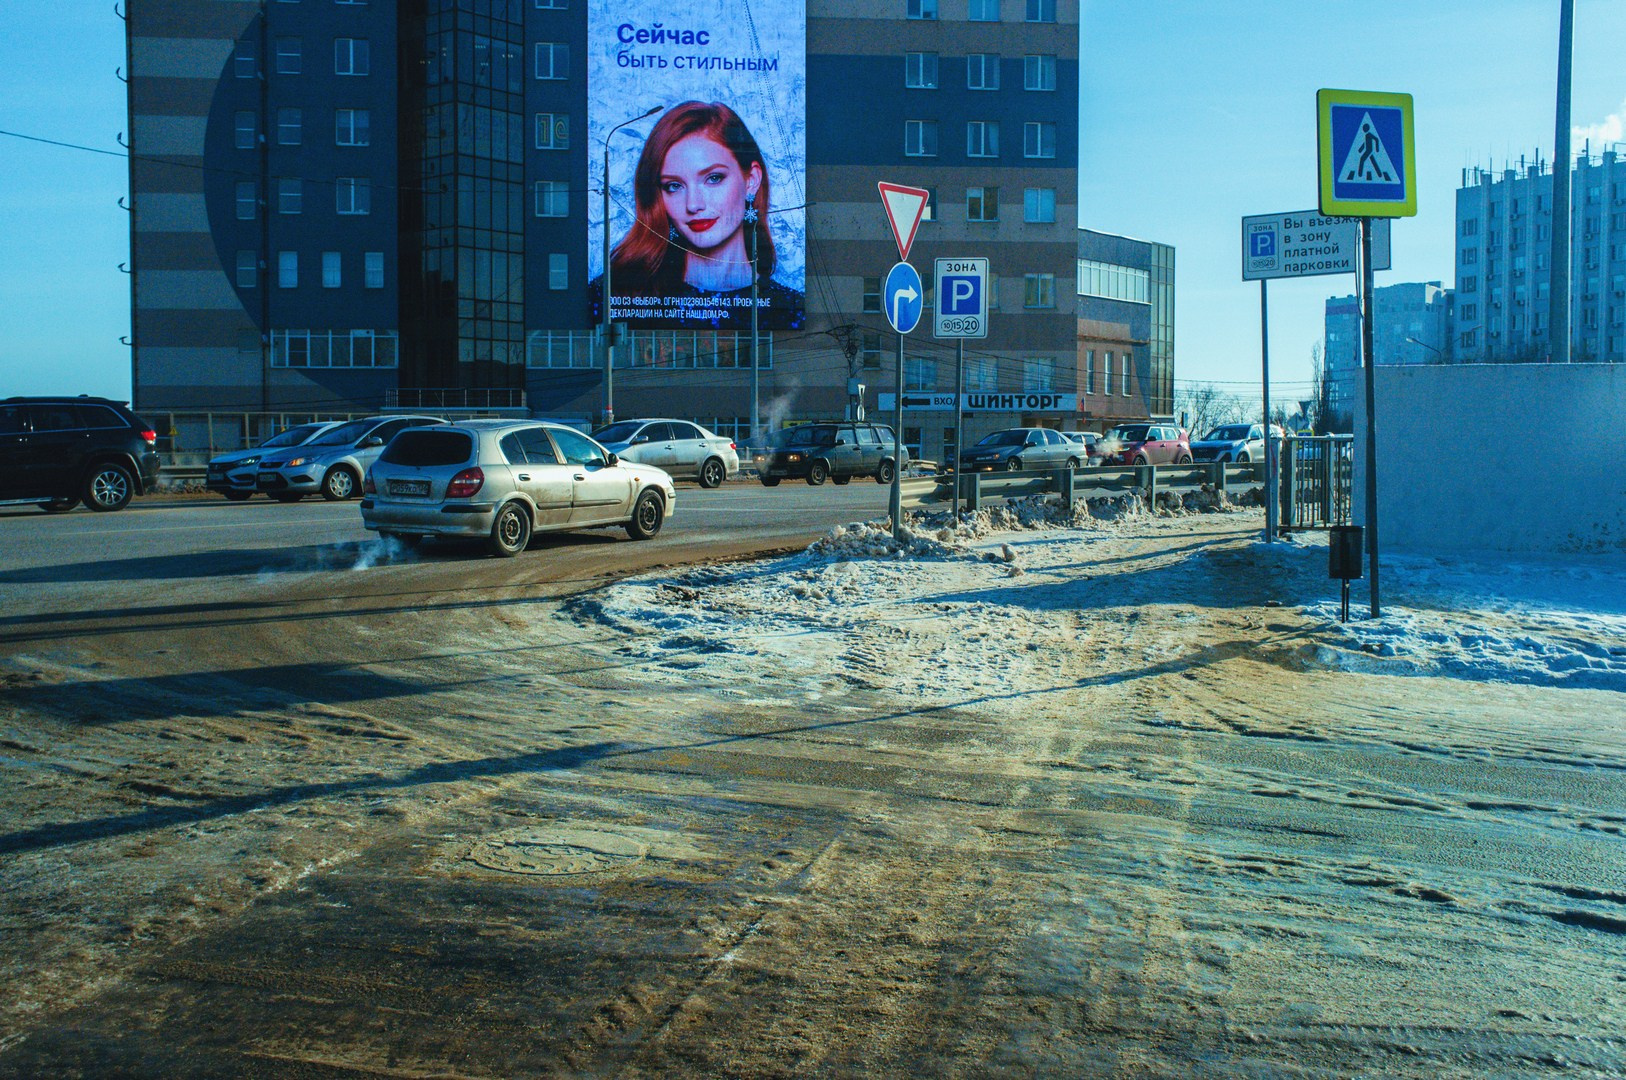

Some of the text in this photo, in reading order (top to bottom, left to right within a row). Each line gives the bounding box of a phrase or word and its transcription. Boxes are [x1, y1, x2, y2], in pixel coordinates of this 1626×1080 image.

[617, 23, 710, 45] Сейчас
[617, 50, 778, 71] быть стильным
[1284, 218, 1303, 229] Вы
[1300, 231, 1331, 243] зону
[1284, 243, 1340, 258] платной
[946, 263, 977, 272] ЗОНА
[1284, 259, 1349, 273] парковки
[952, 280, 974, 311] P
[733, 297, 771, 307] ПРОЕКНЫЕ
[653, 309, 663, 318] НА
[664, 308, 685, 318] САЙТЕ
[953, 322, 962, 330] 15
[964, 320, 978, 330] 20
